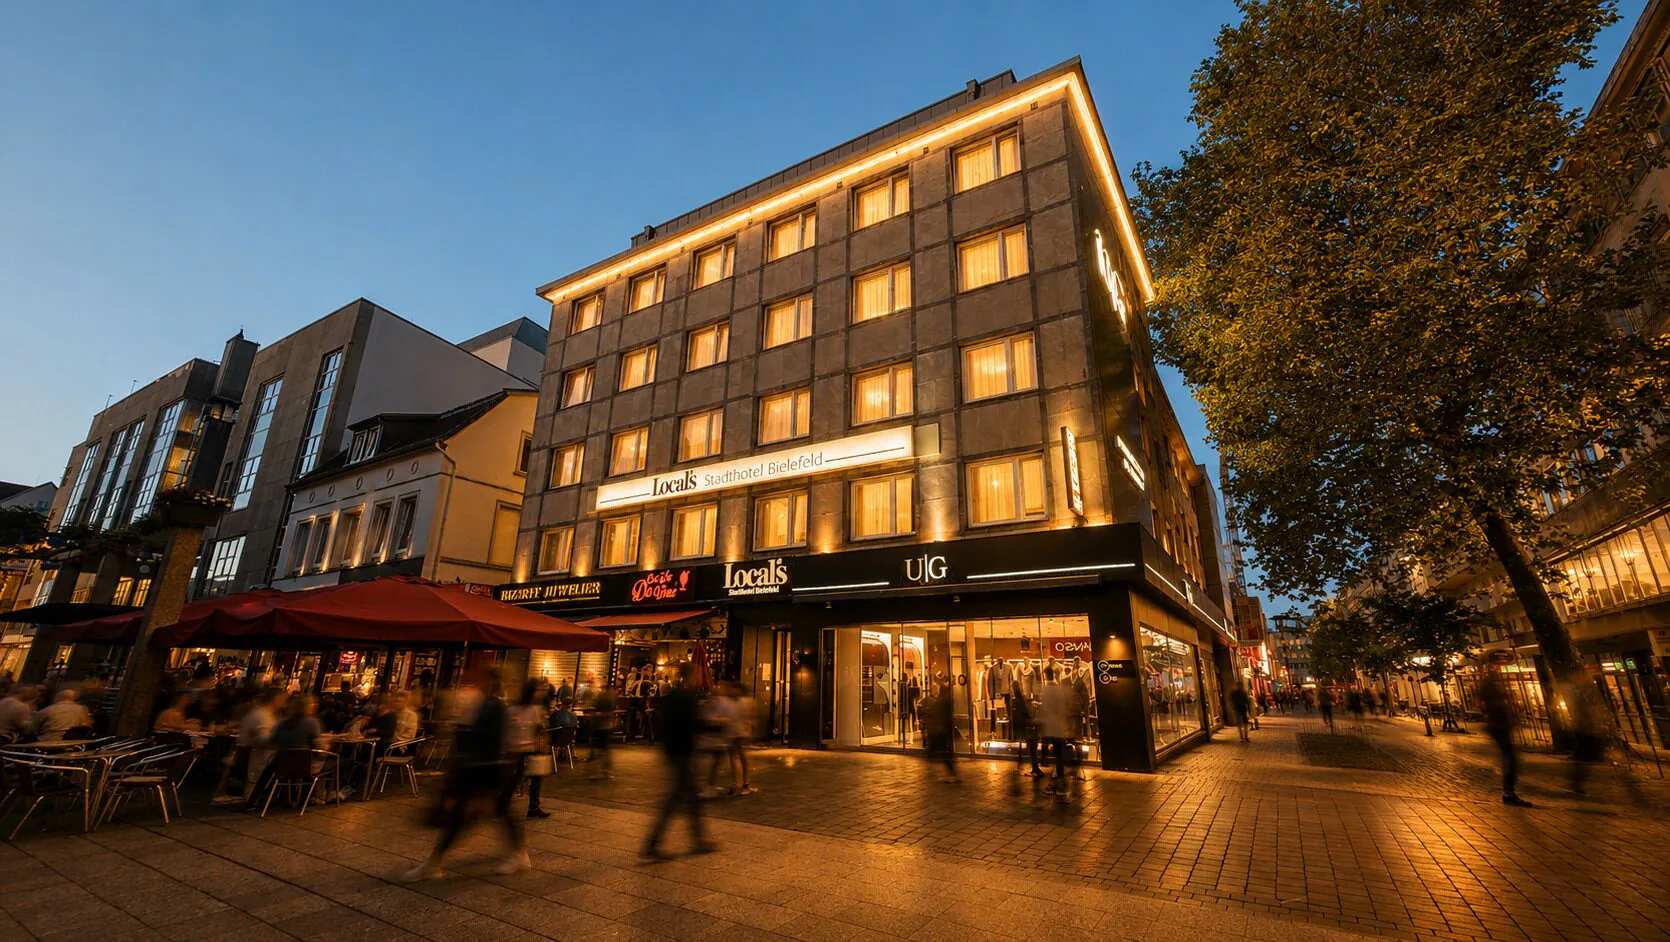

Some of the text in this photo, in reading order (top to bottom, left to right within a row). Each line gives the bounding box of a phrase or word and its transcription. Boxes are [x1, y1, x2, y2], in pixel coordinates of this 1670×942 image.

[651, 452, 823, 496] Local's Stadthotel Bielefeld
[722, 558, 788, 588] Local's
